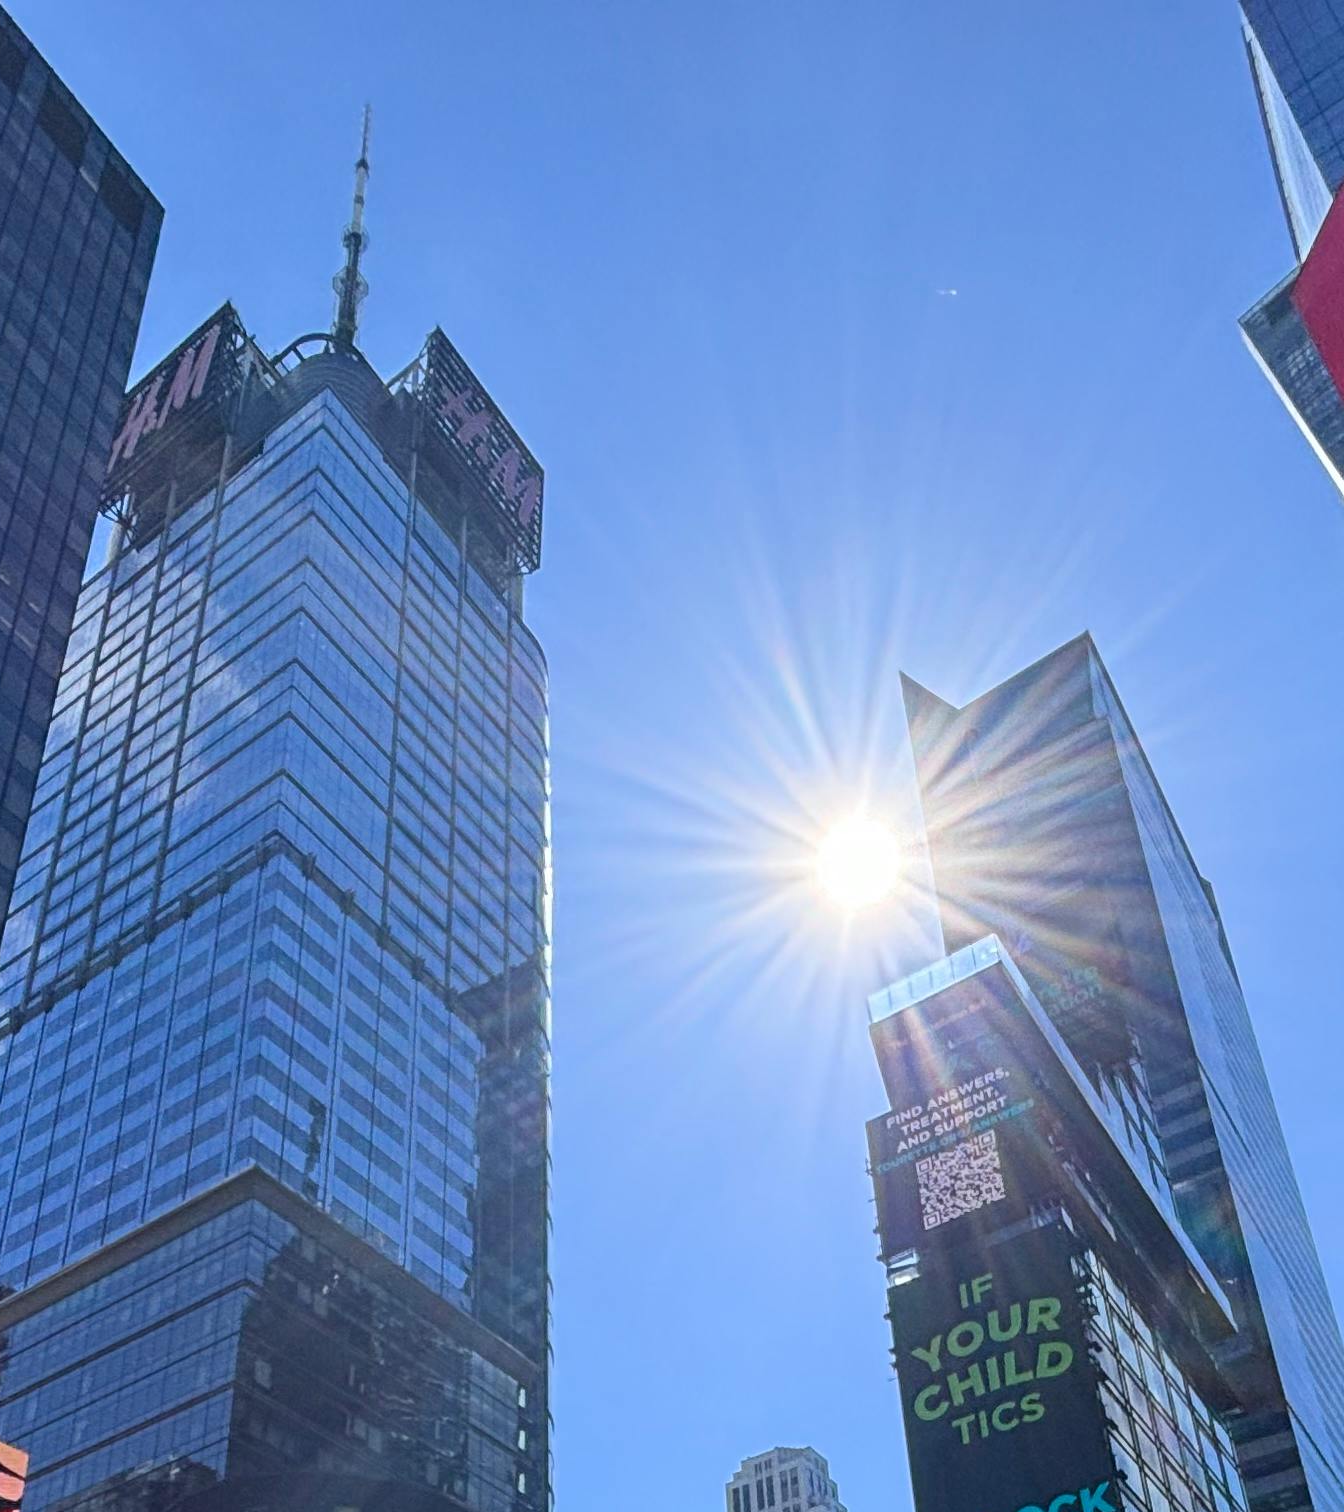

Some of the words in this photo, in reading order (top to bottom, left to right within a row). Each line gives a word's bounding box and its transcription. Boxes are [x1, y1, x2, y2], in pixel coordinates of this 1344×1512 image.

[885, 1105, 923, 1129] FIND
[896, 1131, 932, 1154] AND
[933, 1095, 1007, 1145] SUPPORT
[959, 1272, 994, 1308] IF
[910, 1296, 1062, 1372] YOUR
[913, 1340, 1074, 1423] CHILD
[951, 1391, 1046, 1445] TICS
